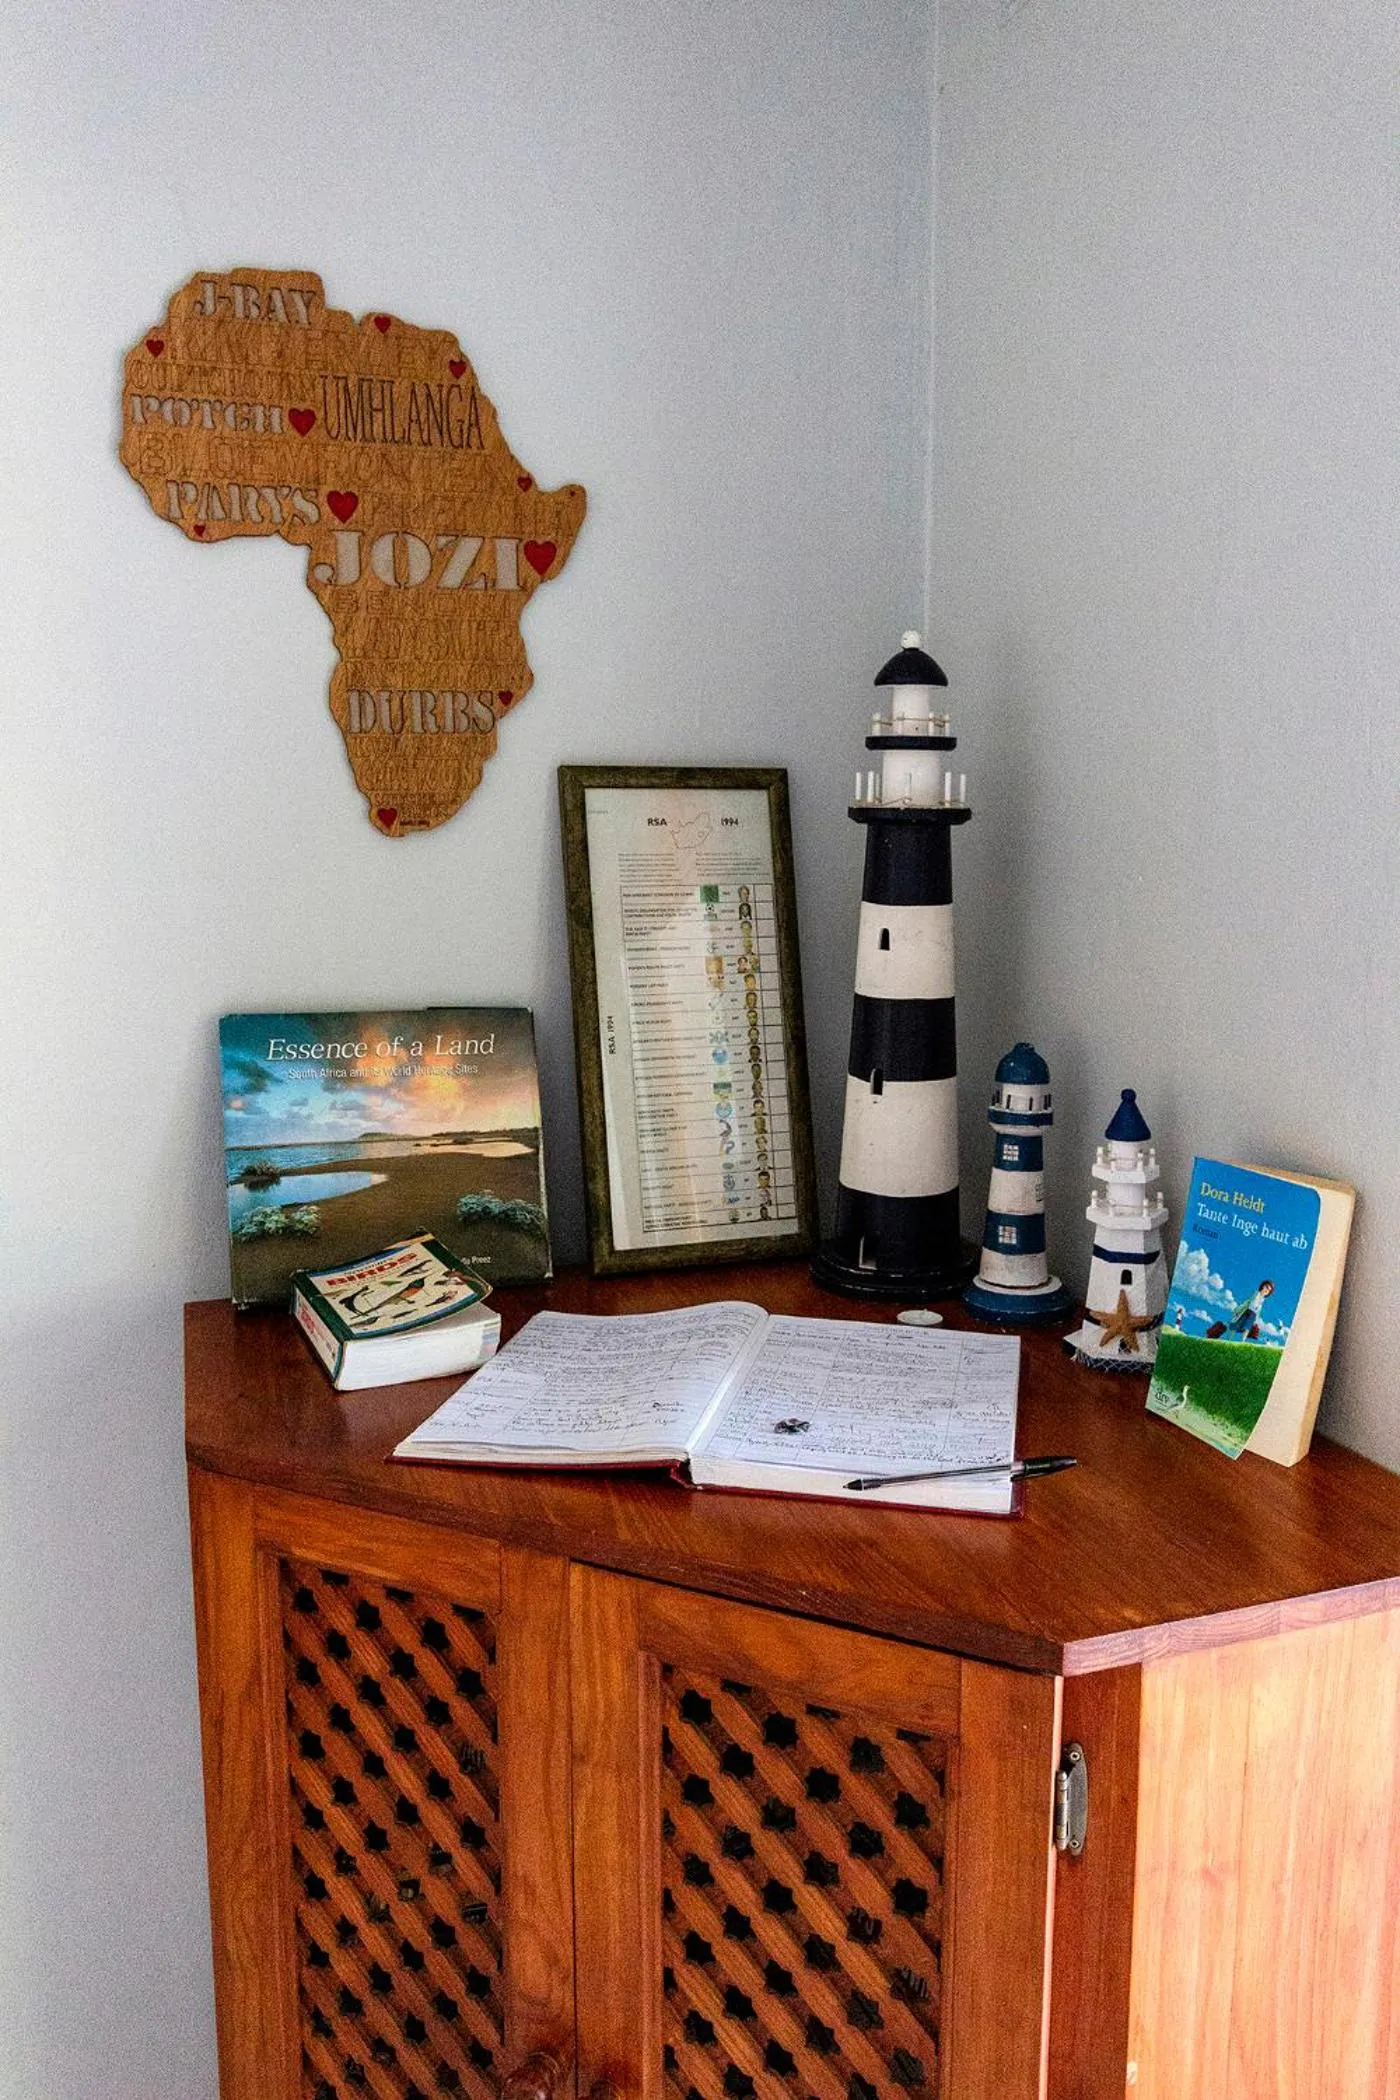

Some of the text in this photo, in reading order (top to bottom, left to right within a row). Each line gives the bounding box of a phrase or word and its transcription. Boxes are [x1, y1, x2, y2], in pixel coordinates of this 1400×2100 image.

[194, 280, 317, 329] J-BAY
[130, 394, 284, 434] POTCH
[319, 374, 486, 450] UMHLANGA
[166, 480, 321, 525] PARYS
[313, 529, 527, 592] JOZI
[347, 688, 497, 735] DURBS
[647, 817, 668, 827] RSA
[720, 817, 740, 827] 1994
[266, 1033, 495, 1061] Essence of a Land
[608, 1036, 616, 1055] RSA
[288, 1067, 318, 1079] South
[319, 1067, 347, 1078] Africa
[349, 1067, 368, 1078] and
[455, 1063, 479, 1075] Sites
[1200, 1181, 1266, 1215] Dora Heldt
[1197, 1202, 1309, 1251] Tante Inge haut ab
[326, 1252, 418, 1287] BIRDS
